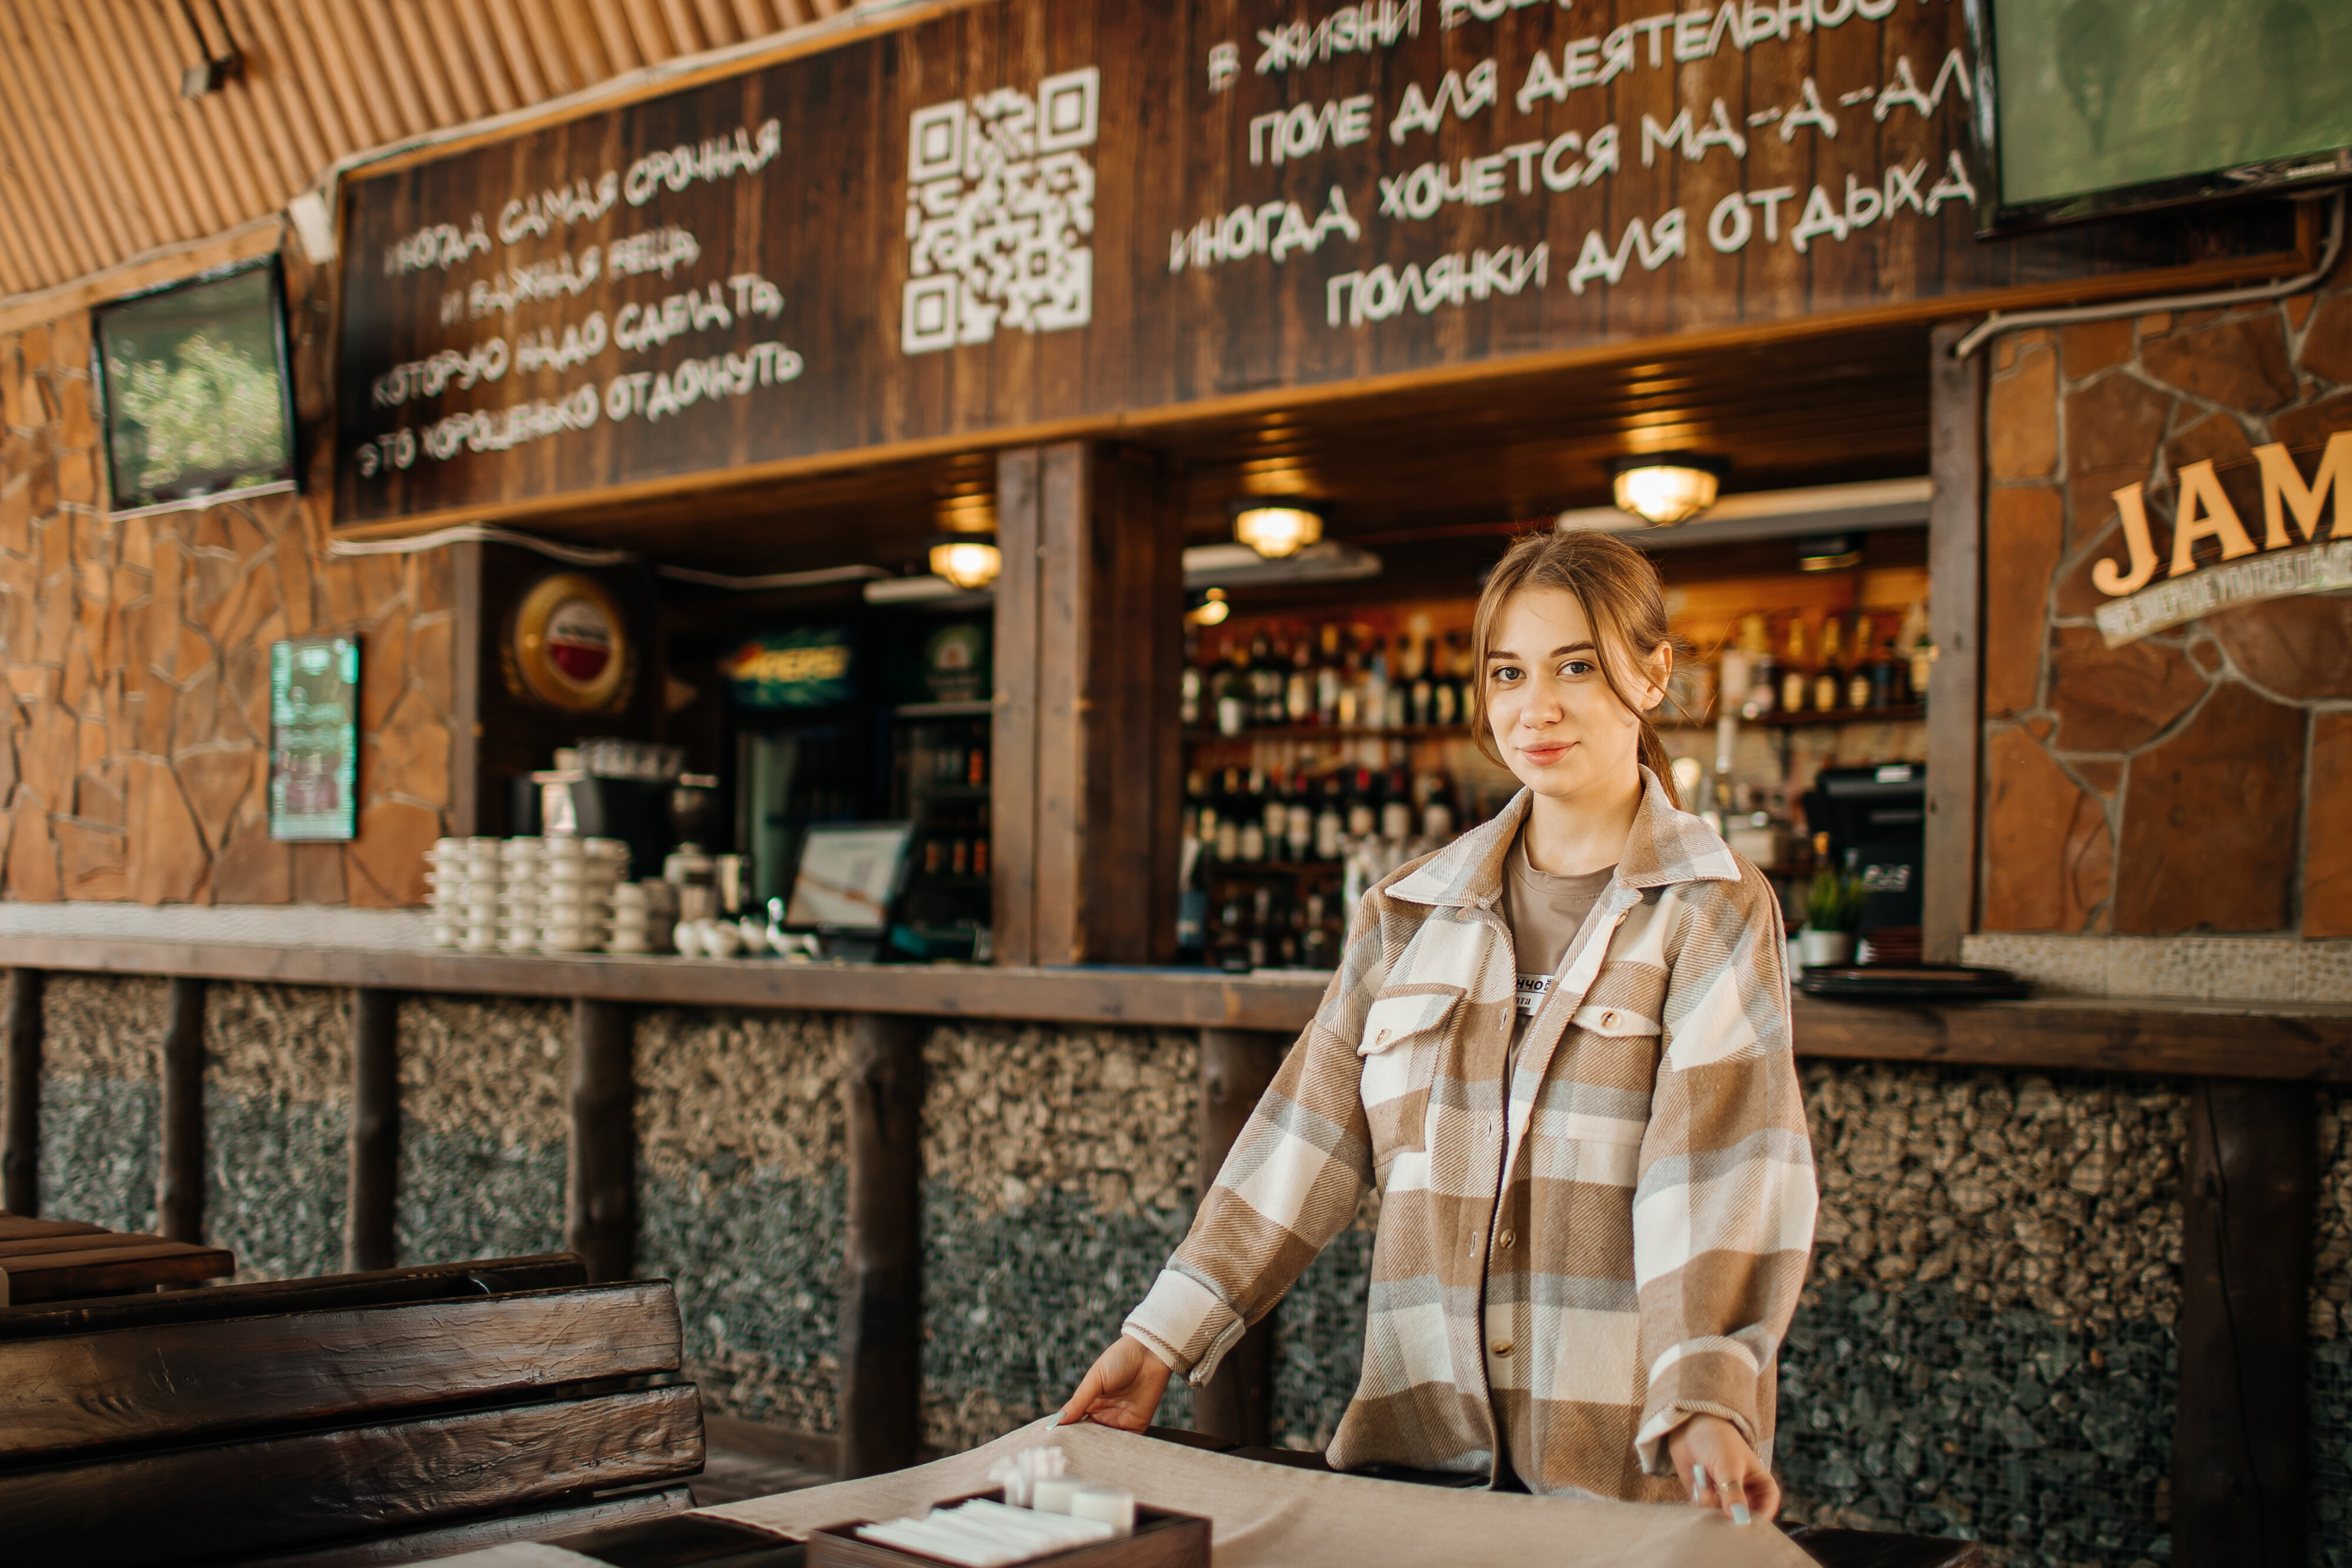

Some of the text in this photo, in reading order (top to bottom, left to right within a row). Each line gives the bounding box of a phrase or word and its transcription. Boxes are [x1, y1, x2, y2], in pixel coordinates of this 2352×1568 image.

[1208, 41, 1239, 93] В
[1254, 0, 1421, 74] ЖИЗНИ
[1249, 93, 1372, 166] ПОЛЕ
[1389, 58, 1498, 145] ДЛЯ
[383, 118, 780, 276] ИНОГДА САМАЯ СРОЧНАЯ
[1169, 185, 1359, 273] ИНОГДА
[1378, 123, 1620, 220] ХОЧЕТСЯ
[1327, 149, 1975, 327] ПОЛЯНКИ ДЛЯ ОТДЫХА
[440, 289, 465, 328] И
[469, 244, 601, 323] ВАЖНАЯ
[357, 341, 804, 477] ЭТО ХОРОШЕНЬКО ОТДОХНУТЬ
[373, 335, 510, 406] КОТОРУЮ
[516, 310, 607, 376] НАДО
[2092, 430, 2352, 596] JAM
